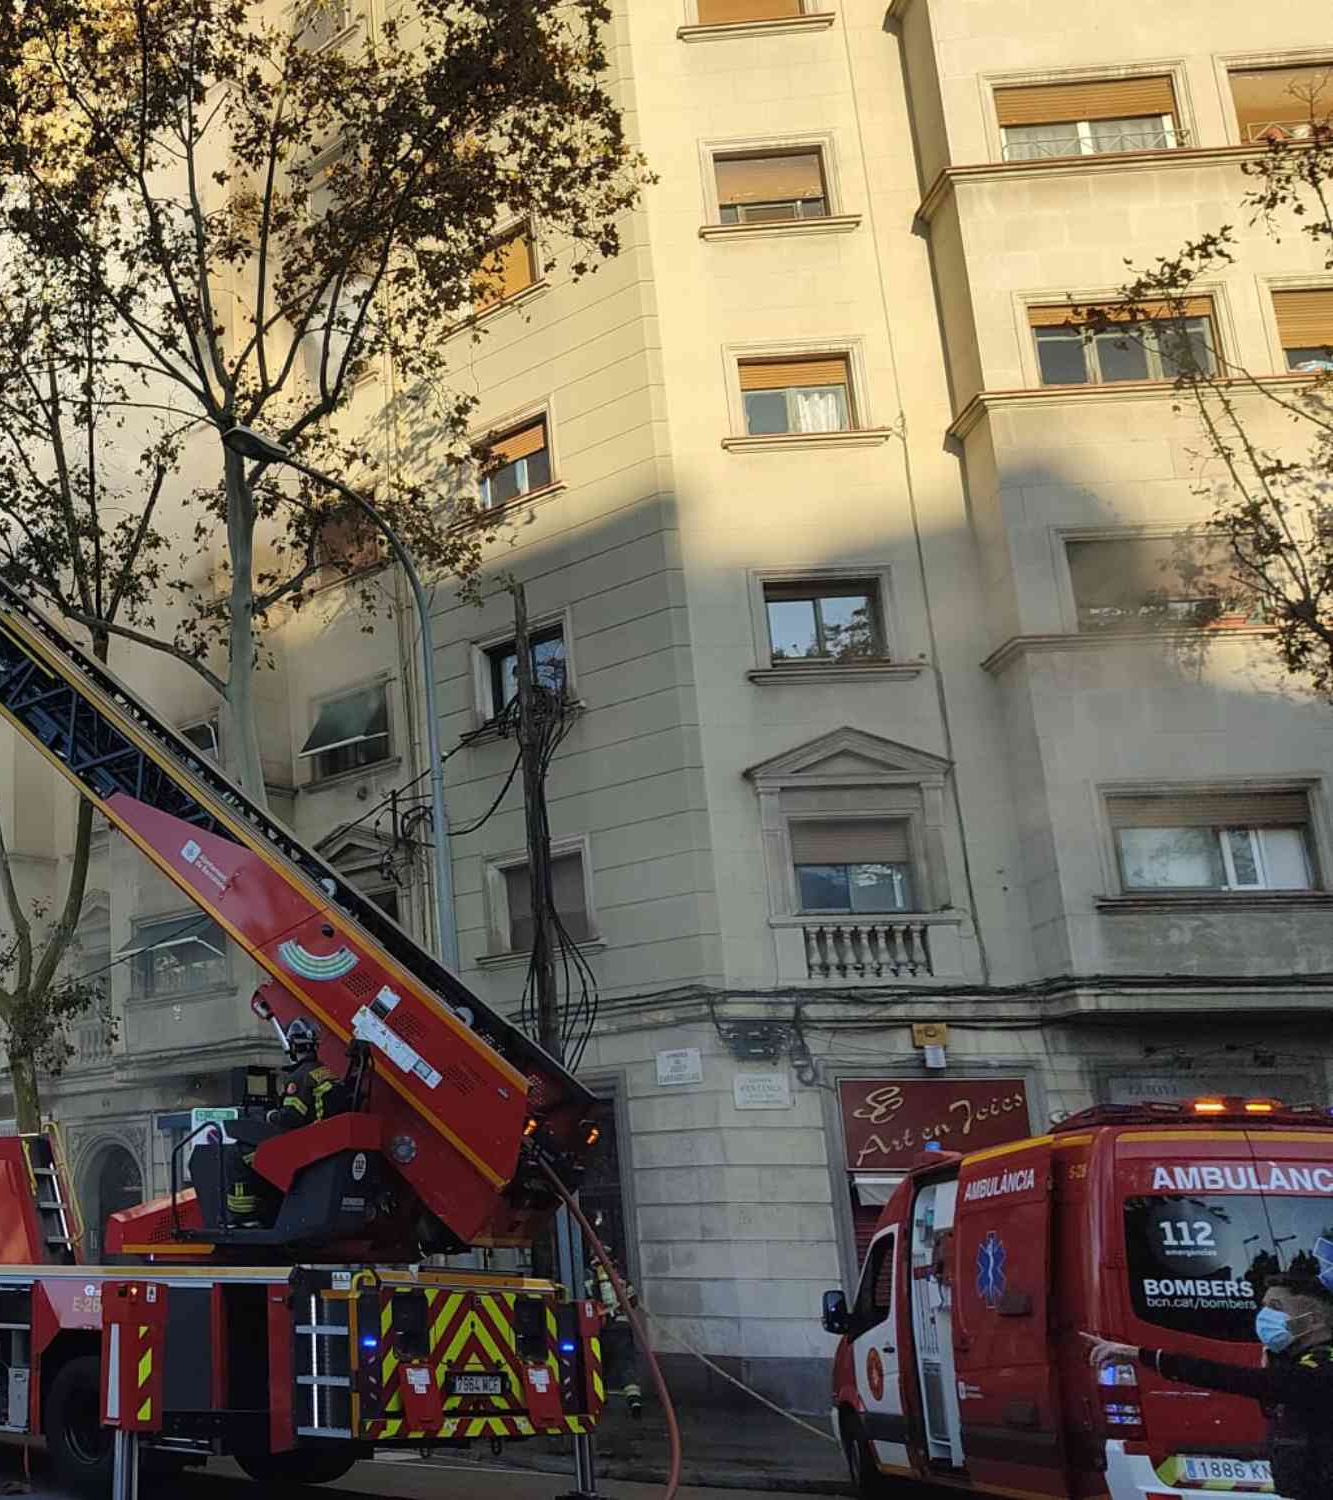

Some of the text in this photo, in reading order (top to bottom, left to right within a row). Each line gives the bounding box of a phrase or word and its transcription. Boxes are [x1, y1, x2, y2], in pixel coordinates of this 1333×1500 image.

[855, 1092, 1024, 1167] Art en Joies
[1159, 1221, 1216, 1246] 112
[1143, 1279, 1255, 1298] BOMBERS
[1146, 1297, 1259, 1311] bcn.cat/bombers
[1198, 1461, 1246, 1479] 1886
